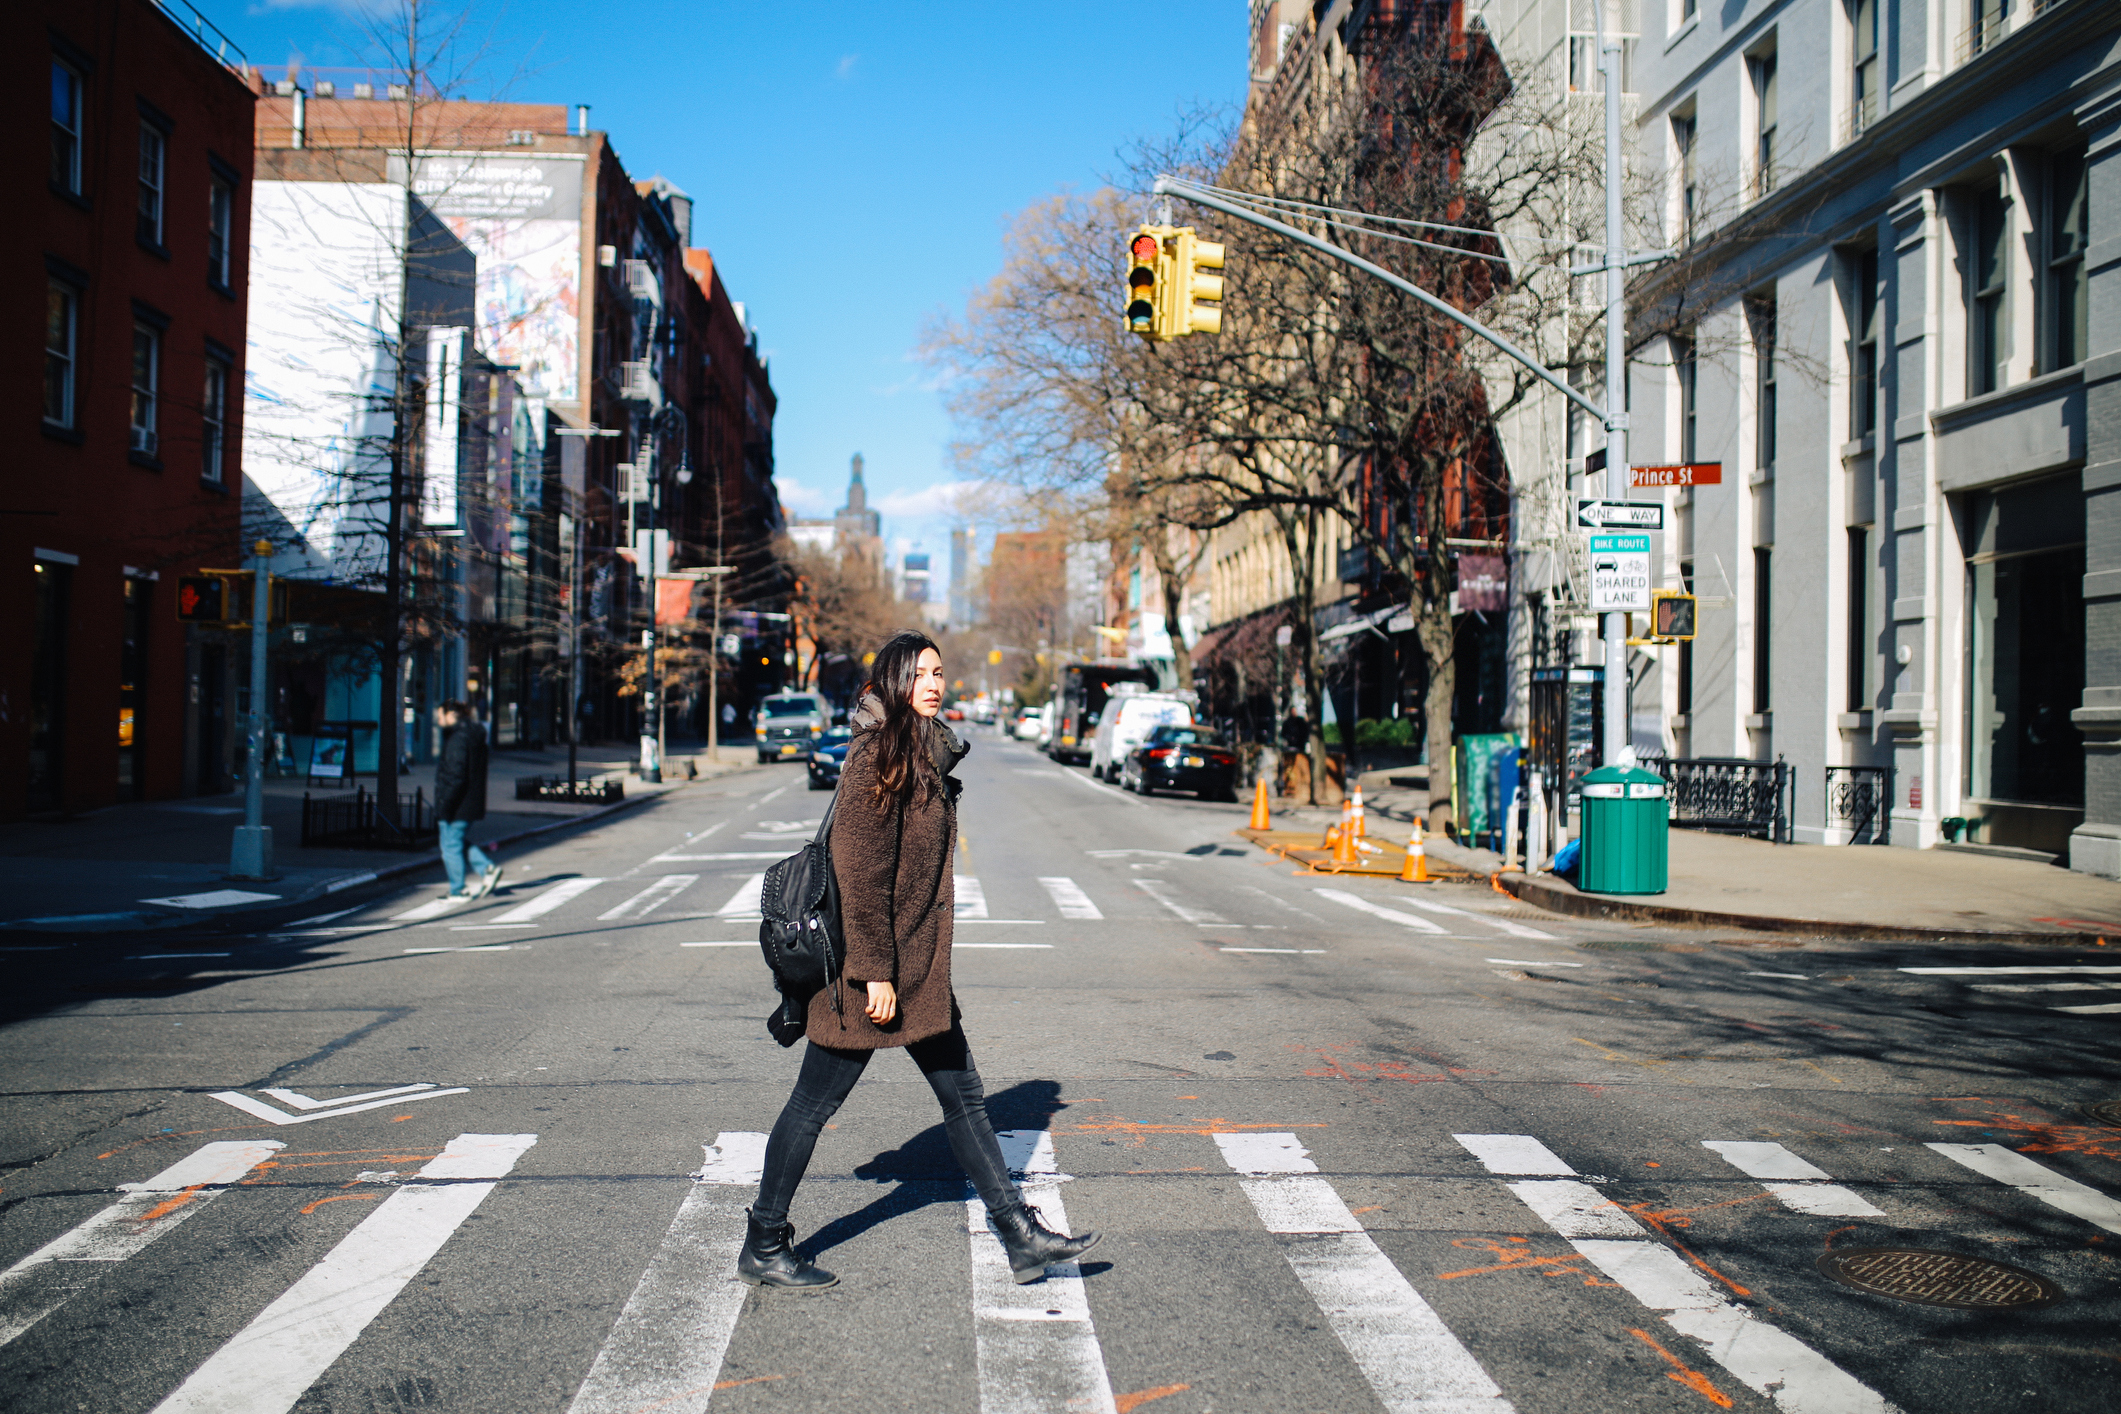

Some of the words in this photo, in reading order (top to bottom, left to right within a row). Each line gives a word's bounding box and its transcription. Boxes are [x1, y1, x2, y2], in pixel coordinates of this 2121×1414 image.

[1631, 468, 1674, 485] Prince
[1679, 467, 1693, 484] St
[1587, 508, 1615, 520] ONE
[1630, 510, 1657, 521] WAY
[1594, 539, 1613, 549] BIKE
[1618, 538, 1645, 549] ROUTE
[1596, 577, 1646, 588] SHARED
[1604, 592, 1637, 603] LANE
